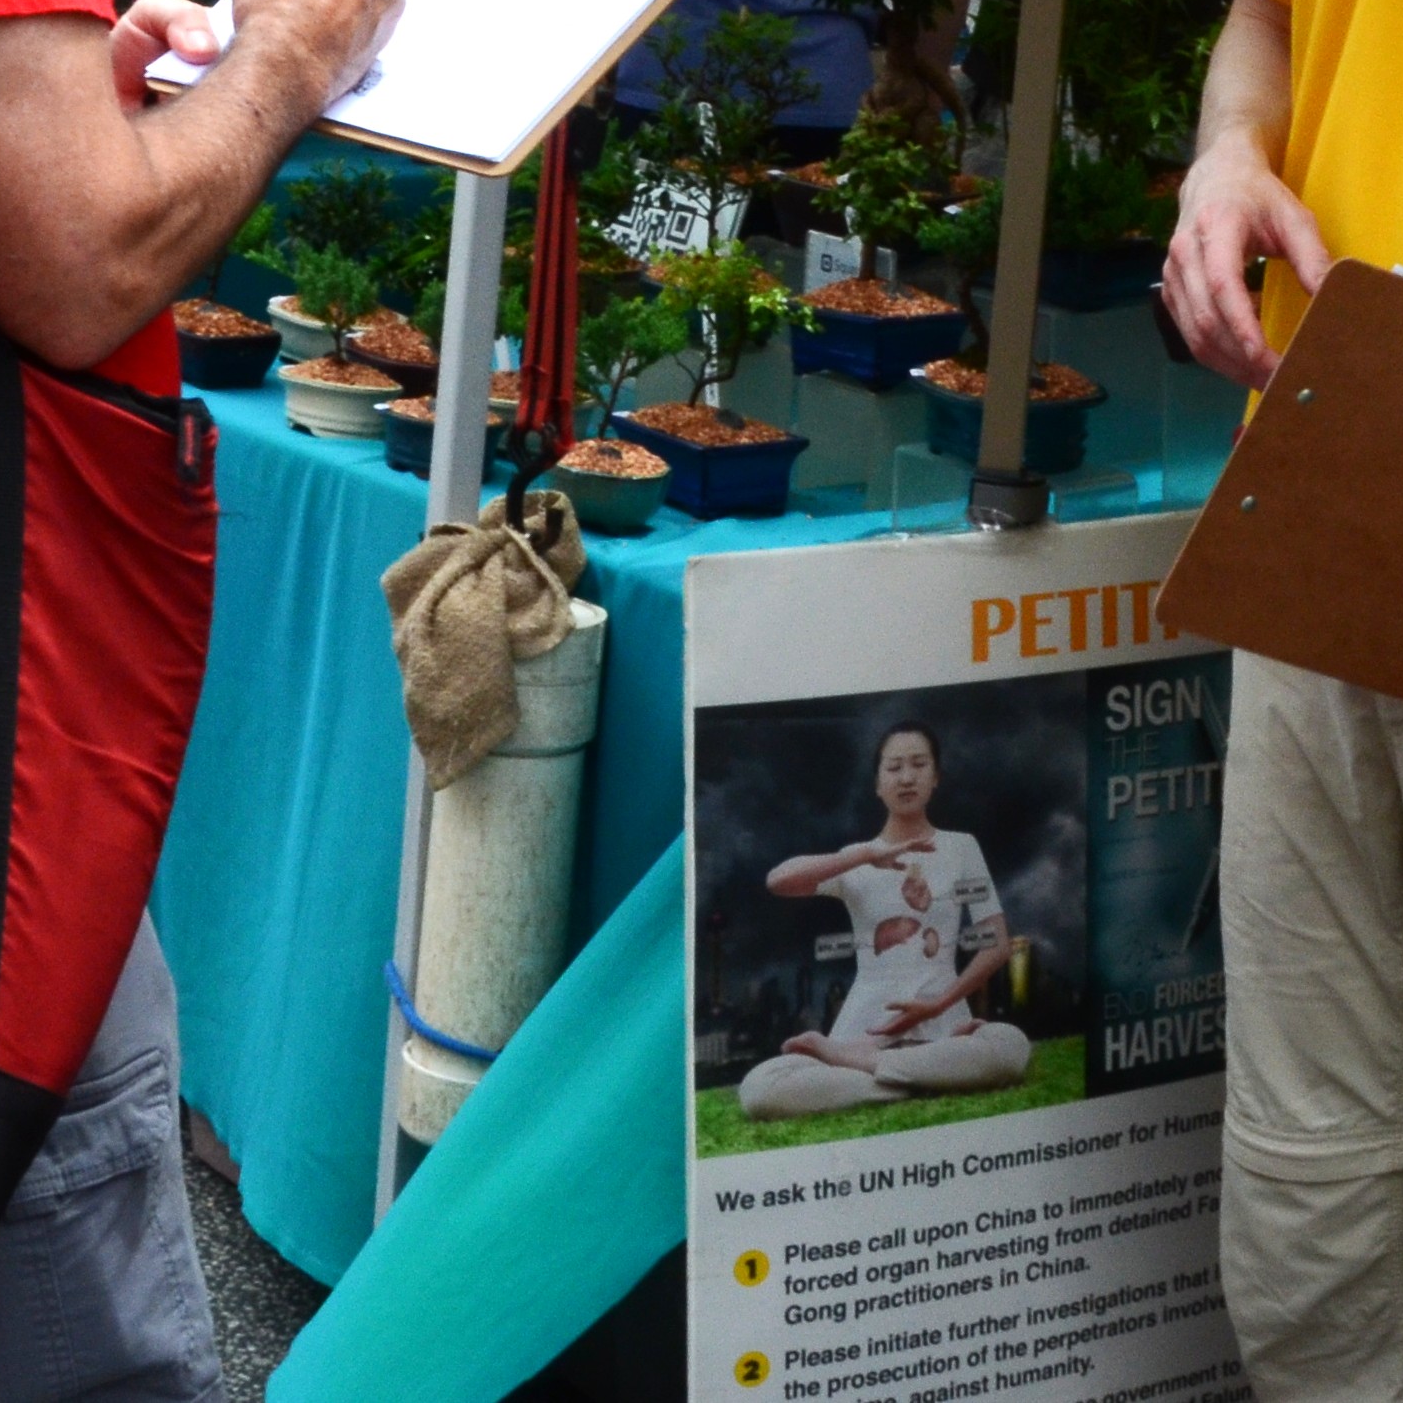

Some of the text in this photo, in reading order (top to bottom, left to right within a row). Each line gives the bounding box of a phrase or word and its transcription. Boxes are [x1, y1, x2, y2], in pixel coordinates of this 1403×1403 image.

[971, 580, 1179, 663] PETIT
[1105, 676, 1202, 731] SIGN
[1106, 731, 1160, 770] THE
[1154, 972, 1225, 1010] FORCE
[715, 1190, 755, 1212] We
[762, 1183, 806, 1207] ask
[813, 1178, 852, 1200] the
[859, 1169, 894, 1193] UN
[902, 1159, 955, 1188] High
[963, 1130, 1123, 1176] Commissioner
[1129, 1123, 1158, 1144] for
[745, 1258, 757, 1280] 1
[784, 1238, 861, 1264] Please
[868, 1228, 906, 1252] call
[913, 1220, 968, 1248] upon
[975, 1208, 1036, 1233] China
[1043, 1203, 1063, 1219] to
[1070, 1174, 1189, 1214] immediately
[784, 1268, 858, 1295] forced
[865, 1257, 929, 1284] organ
[937, 1235, 1049, 1270] harvesting
[1056, 1222, 1102, 1247] from
[1108, 1200, 1192, 1236] detained
[742, 1360, 760, 1381] 2
[784, 1345, 861, 1370] Please
[867, 1328, 942, 1357] initiate
[949, 1312, 1020, 1342] further
[1026, 1280, 1168, 1326] investigations
[1173, 1268, 1210, 1293] that
[784, 1255, 1091, 1325] Gong practitioners in China.
[784, 1380, 820, 1400] the
[827, 1354, 960, 1398] prosecution
[967, 1346, 989, 1366] of
[994, 1339, 1028, 1362] the
[1033, 1310, 1158, 1357] perpetrators
[910, 1356, 1095, 1403] against humanity.
[1223, 1360, 1242, 1377] to
